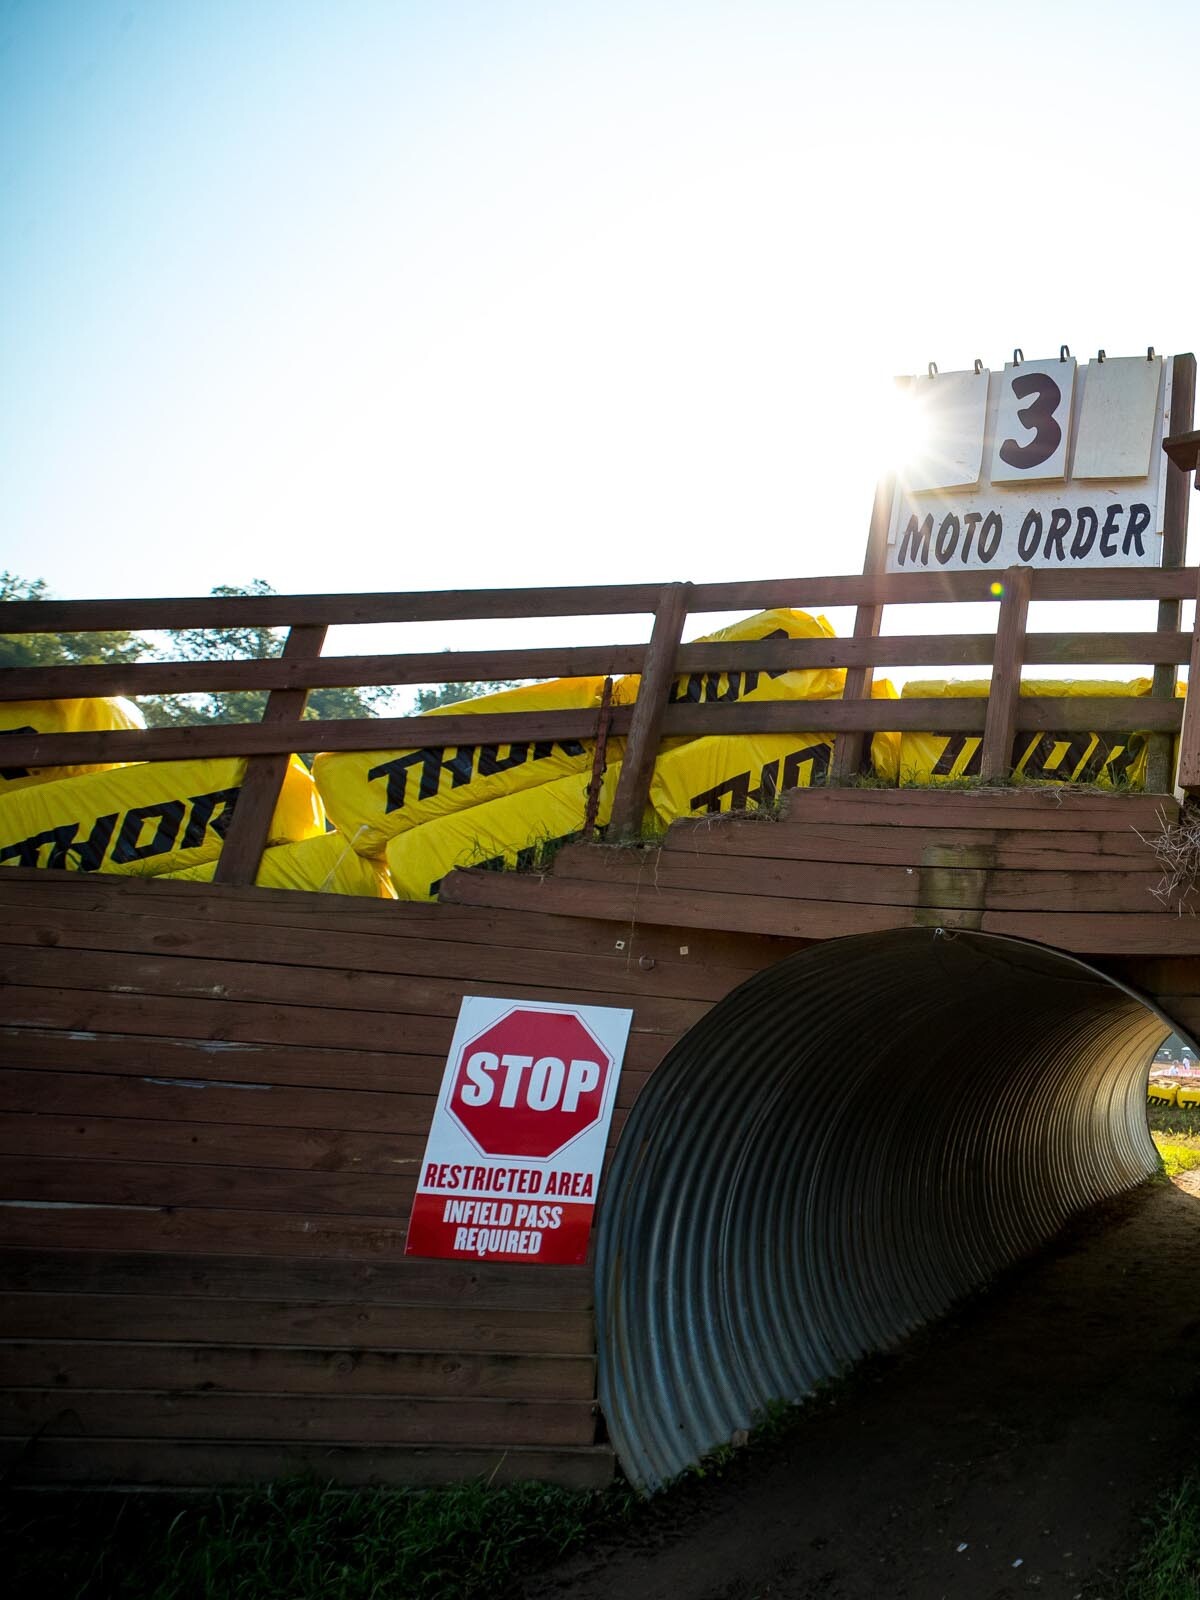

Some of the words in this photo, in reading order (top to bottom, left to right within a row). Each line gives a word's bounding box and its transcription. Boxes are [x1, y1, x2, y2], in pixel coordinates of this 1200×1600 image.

[1000, 373, 1061, 469] 3
[897, 510, 1003, 566] MOTO
[1017, 503, 1151, 563] ORDER
[461, 1052, 600, 1112] STOP
[423, 1163, 542, 1194] RESTRICTED
[544, 1172, 593, 1198] AREA
[443, 1200, 511, 1226] INFIELD
[516, 1206, 563, 1229] PASS
[454, 1228, 542, 1256] REQUIRED
